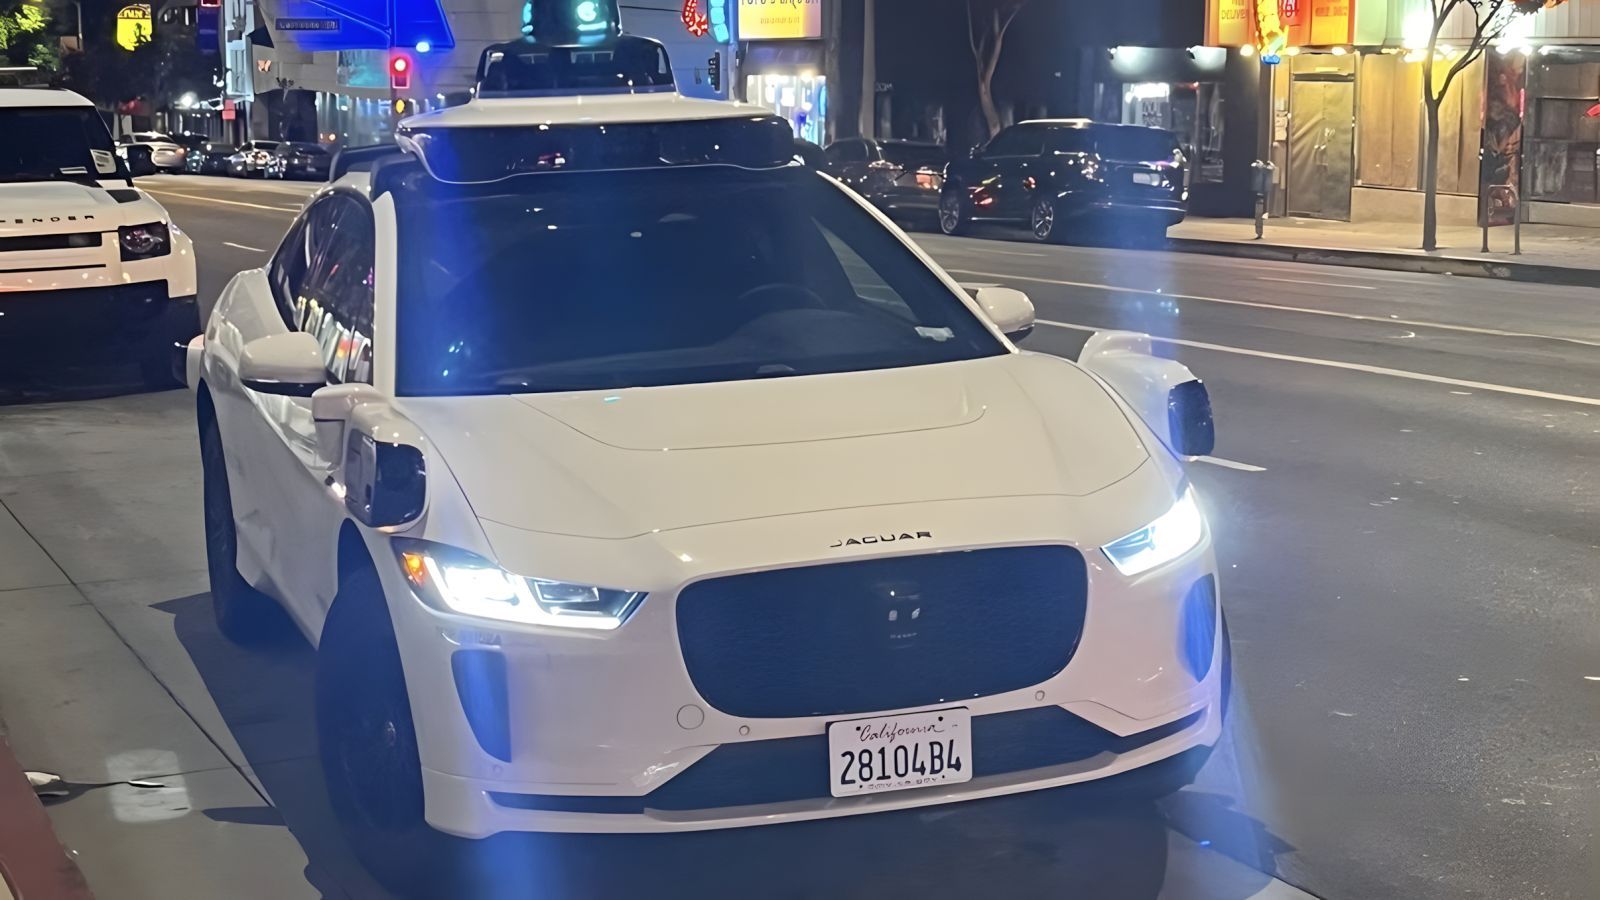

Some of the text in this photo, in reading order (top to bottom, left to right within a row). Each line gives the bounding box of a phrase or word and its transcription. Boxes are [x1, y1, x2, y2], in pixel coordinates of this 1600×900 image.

[830, 531, 932, 548] JAGUAR
[859, 722, 945, 743] California
[840, 739, 962, 785] 28104B4
